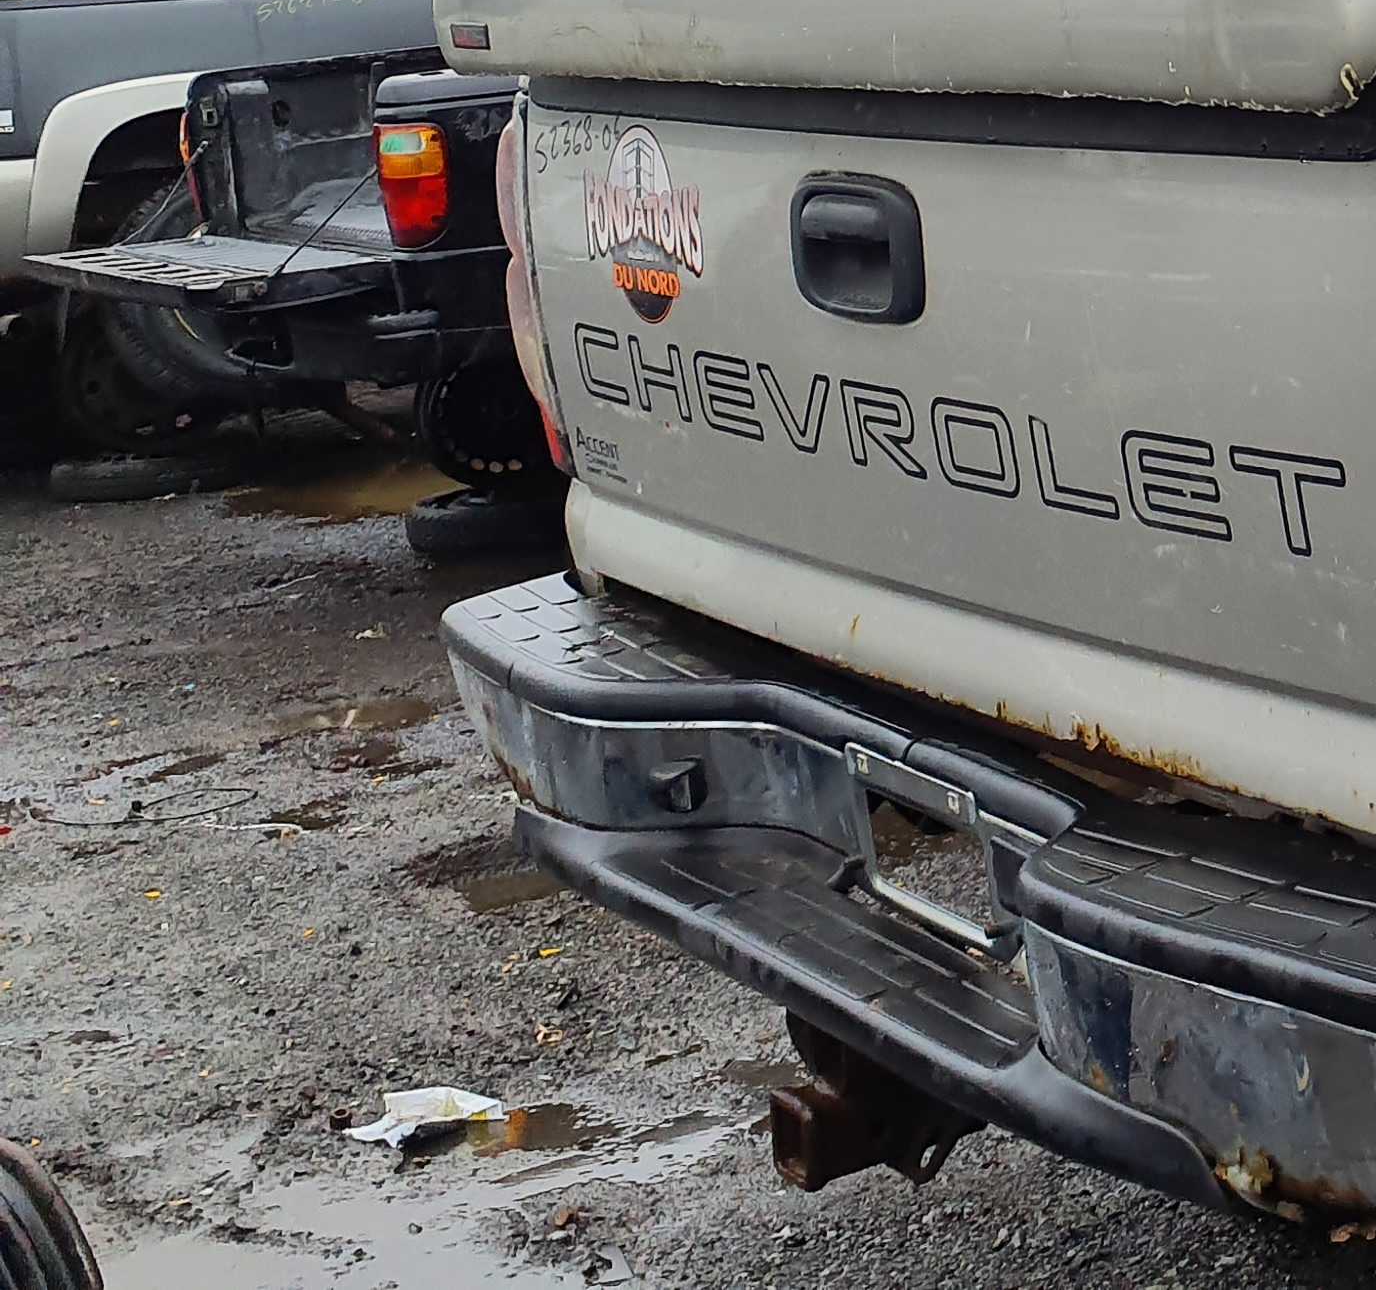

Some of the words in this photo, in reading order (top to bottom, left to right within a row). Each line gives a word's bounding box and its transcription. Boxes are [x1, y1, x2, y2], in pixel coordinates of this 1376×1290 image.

[613, 262, 635, 288] DU
[637, 269, 680, 300] NORD
[574, 322, 1346, 557] CHEVROLET
